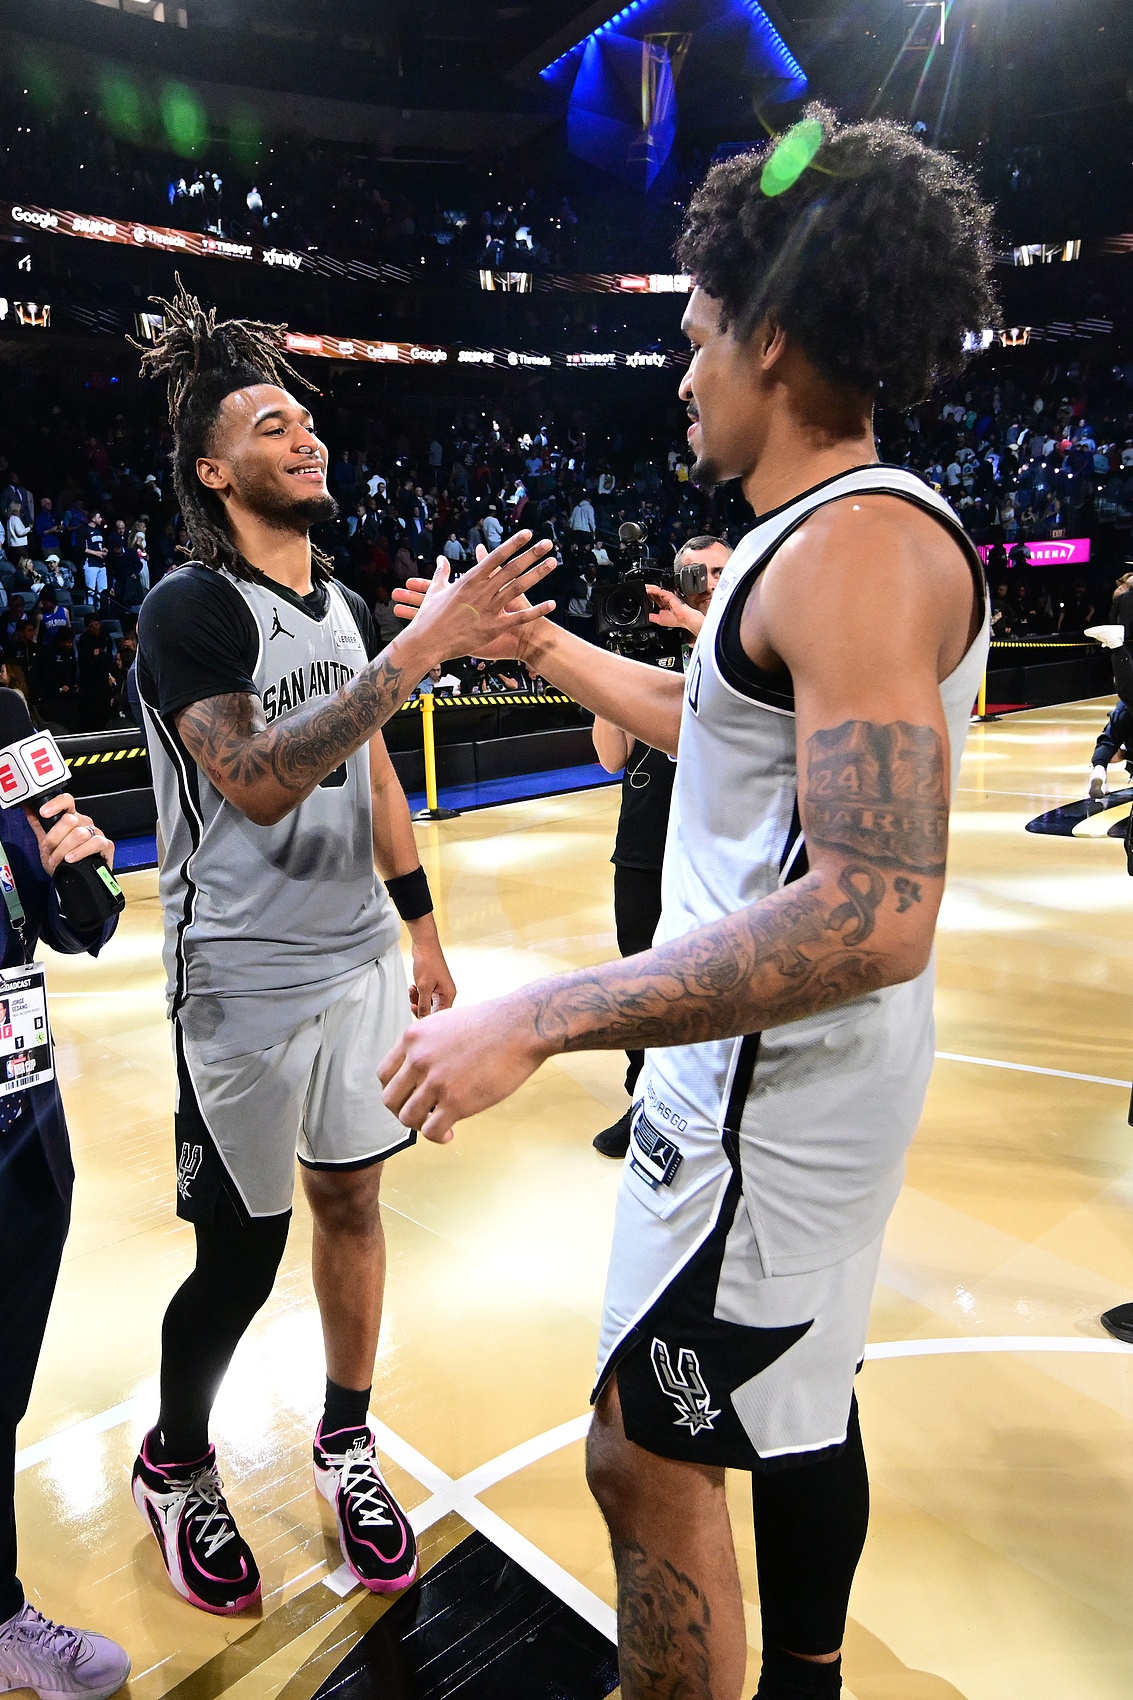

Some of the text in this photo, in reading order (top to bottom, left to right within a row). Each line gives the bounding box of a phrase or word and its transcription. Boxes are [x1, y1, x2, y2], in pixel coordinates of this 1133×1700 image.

[11, 206, 58, 229] Google
[146, 230, 186, 247] Threads
[216, 241, 253, 256] TISSOT
[262, 248, 302, 270] xfinity
[411, 347, 448, 363] Google
[518, 353, 551, 366] Threads
[580, 353, 616, 363] TISSOT
[625, 351, 666, 368] xfinity
[1030, 549, 1066, 560] ARENA
[338, 635, 357, 644] LEDGER
[263, 666, 306, 726] SAN
[670, 1113, 688, 1132] GO
